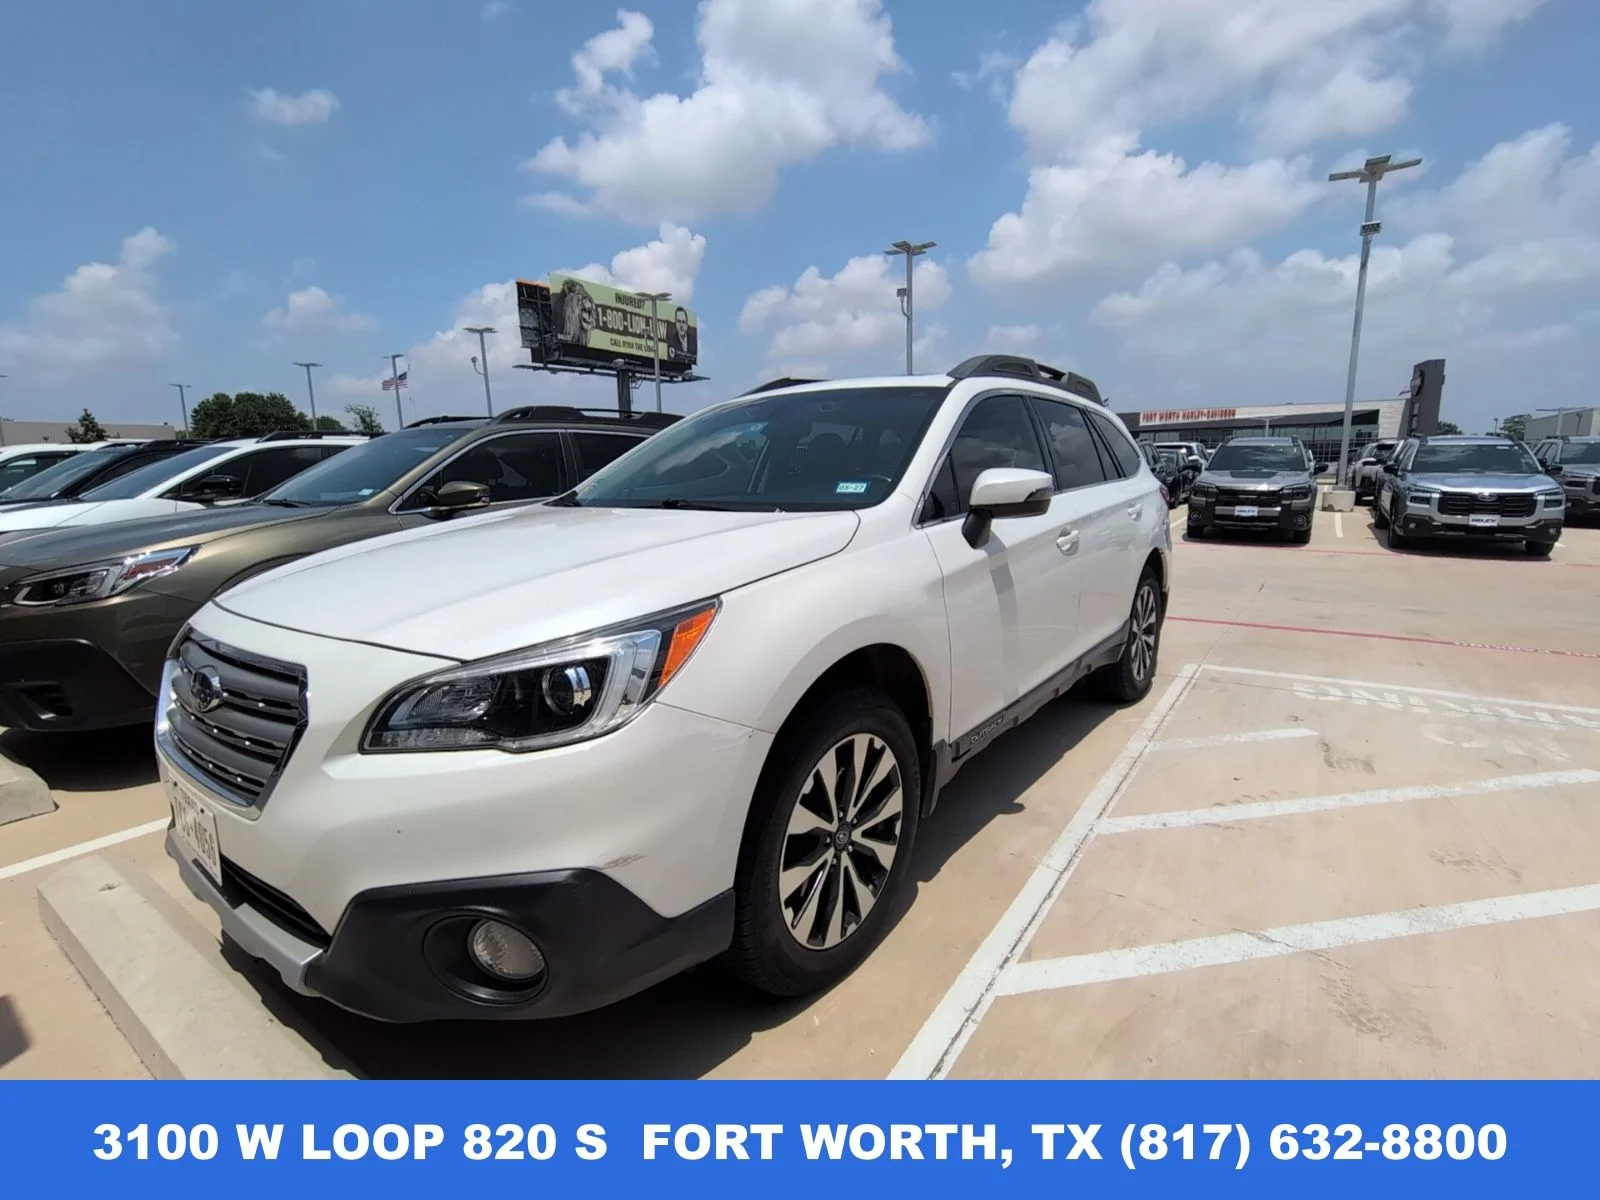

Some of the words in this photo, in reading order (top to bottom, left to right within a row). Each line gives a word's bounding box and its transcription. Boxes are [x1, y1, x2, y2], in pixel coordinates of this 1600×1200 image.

[615, 292, 646, 310] INJURED?
[610, 337, 621, 347] CALL
[635, 342, 643, 351] THE
[1142, 411, 1157, 422] FORT
[1159, 411, 1180, 421] WORTH
